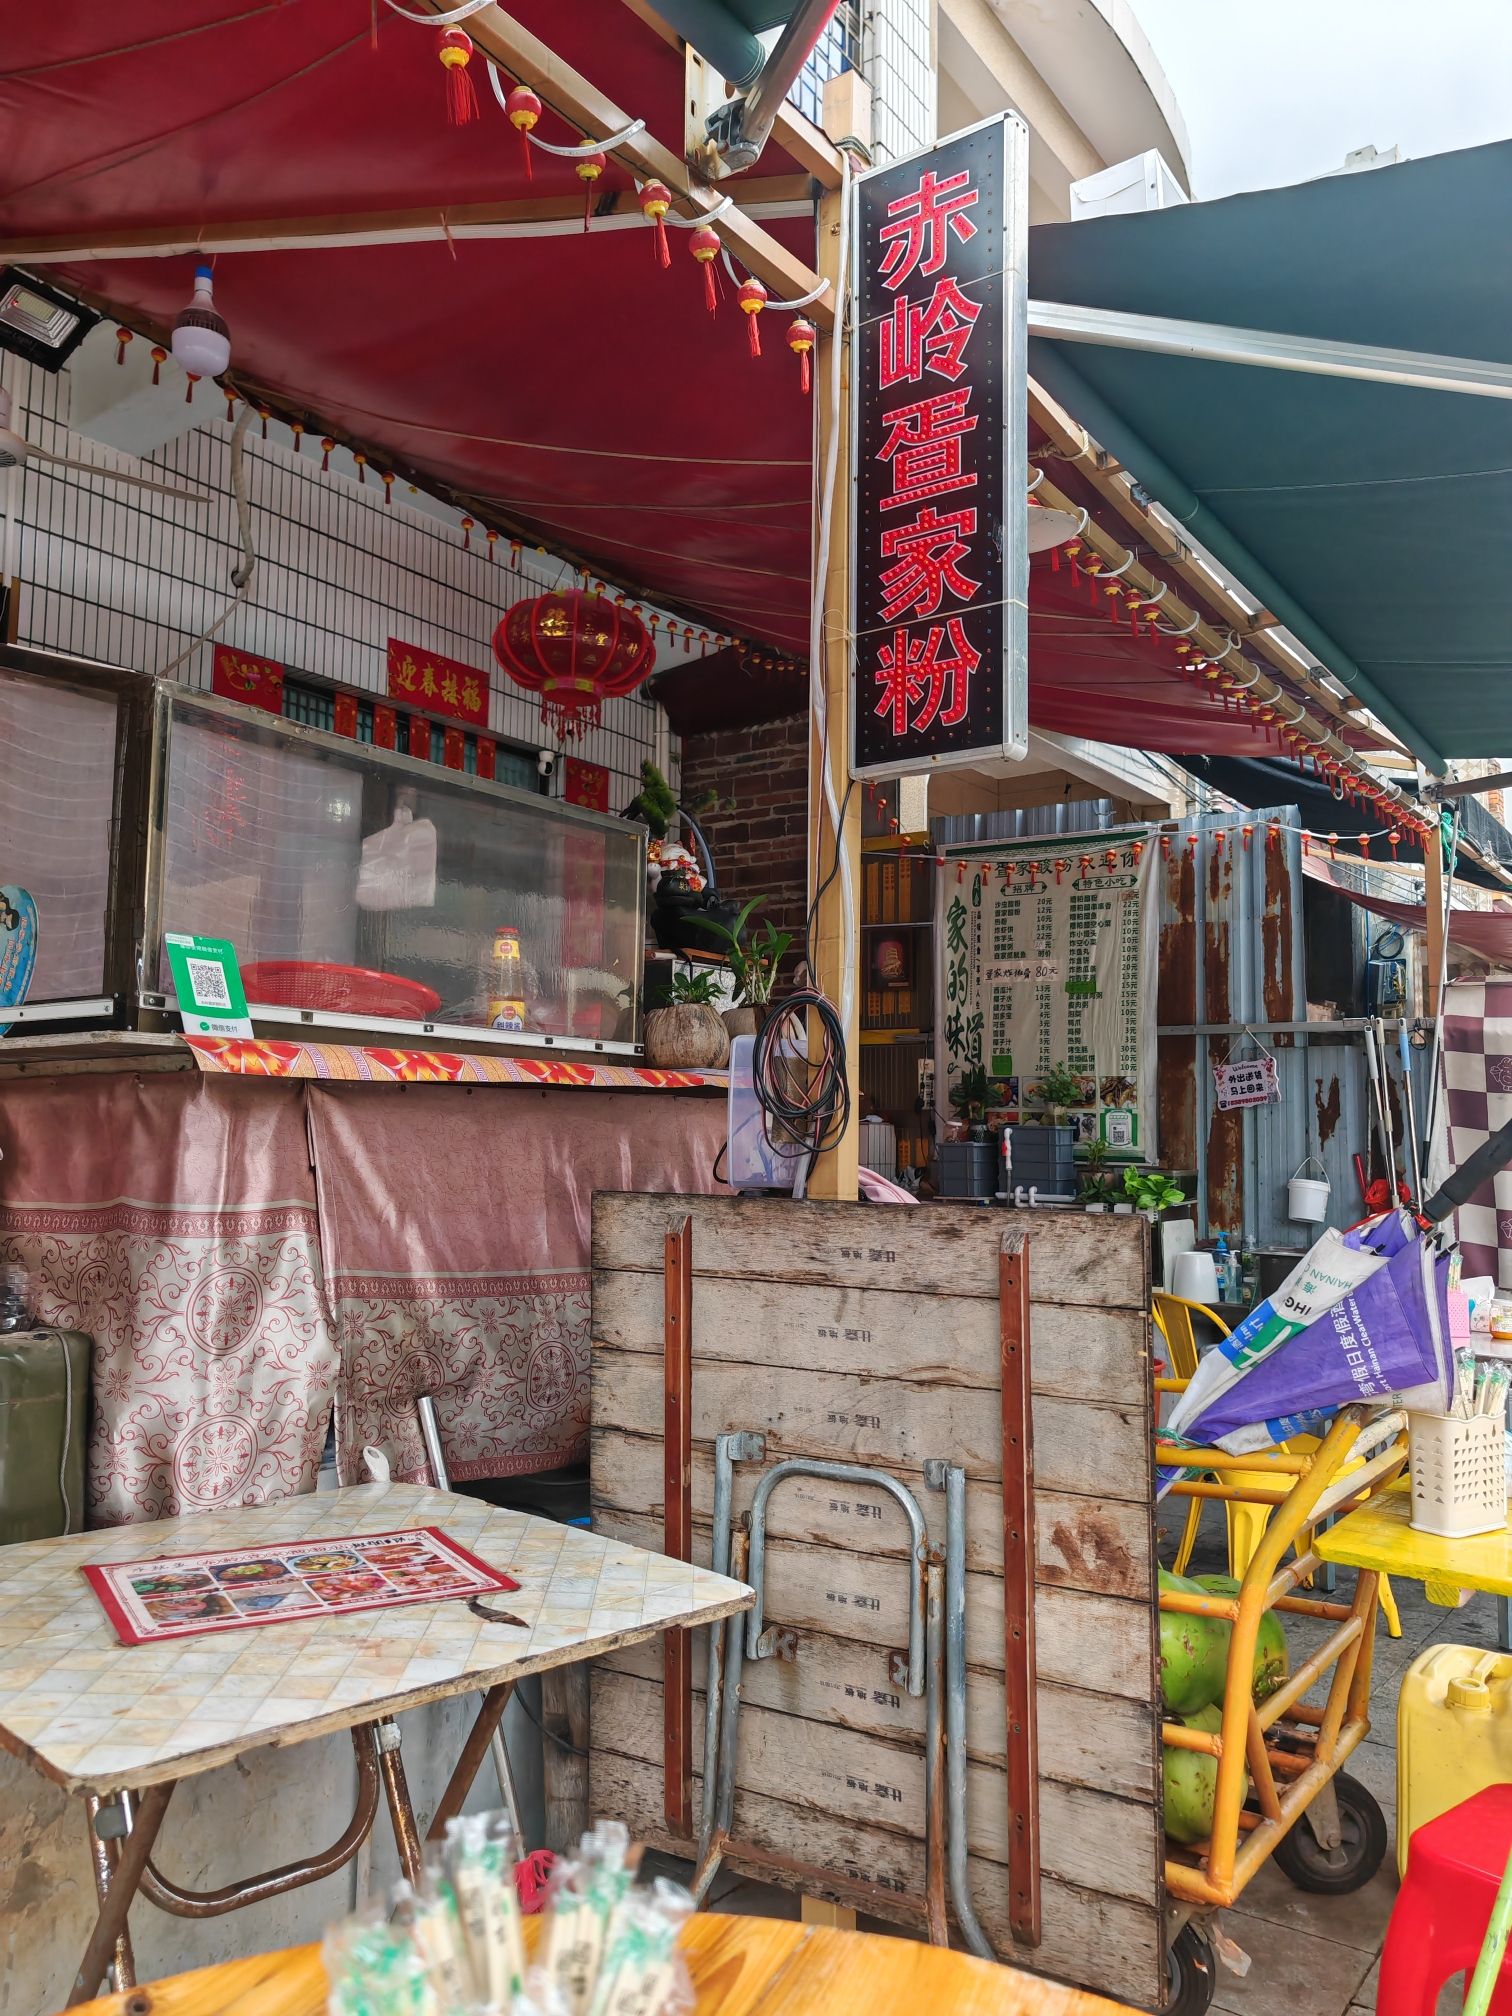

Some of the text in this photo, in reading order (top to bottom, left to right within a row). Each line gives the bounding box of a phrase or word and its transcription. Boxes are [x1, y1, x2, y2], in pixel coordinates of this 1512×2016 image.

[875, 170, 982, 737] 赤岭疍家粉
[396, 655, 481, 712] 迎春接福
[1083, 877, 1127, 888] 特色小吃
[1036, 966, 1058, 977] 80元
[211, 1023, 238, 1033] 微信支付
[1035, 1064, 1050, 1072] 20元
[1229, 1071, 1262, 1083] 外出送货
[1230, 1083, 1264, 1095] 马上回来
[1310, 1268, 1352, 1289] HAINAN
[1284, 1296, 1311, 1315] IHG
[1348, 1298, 1371, 1346] ClearWater
[1368, 1348, 1383, 1379] Hainan
